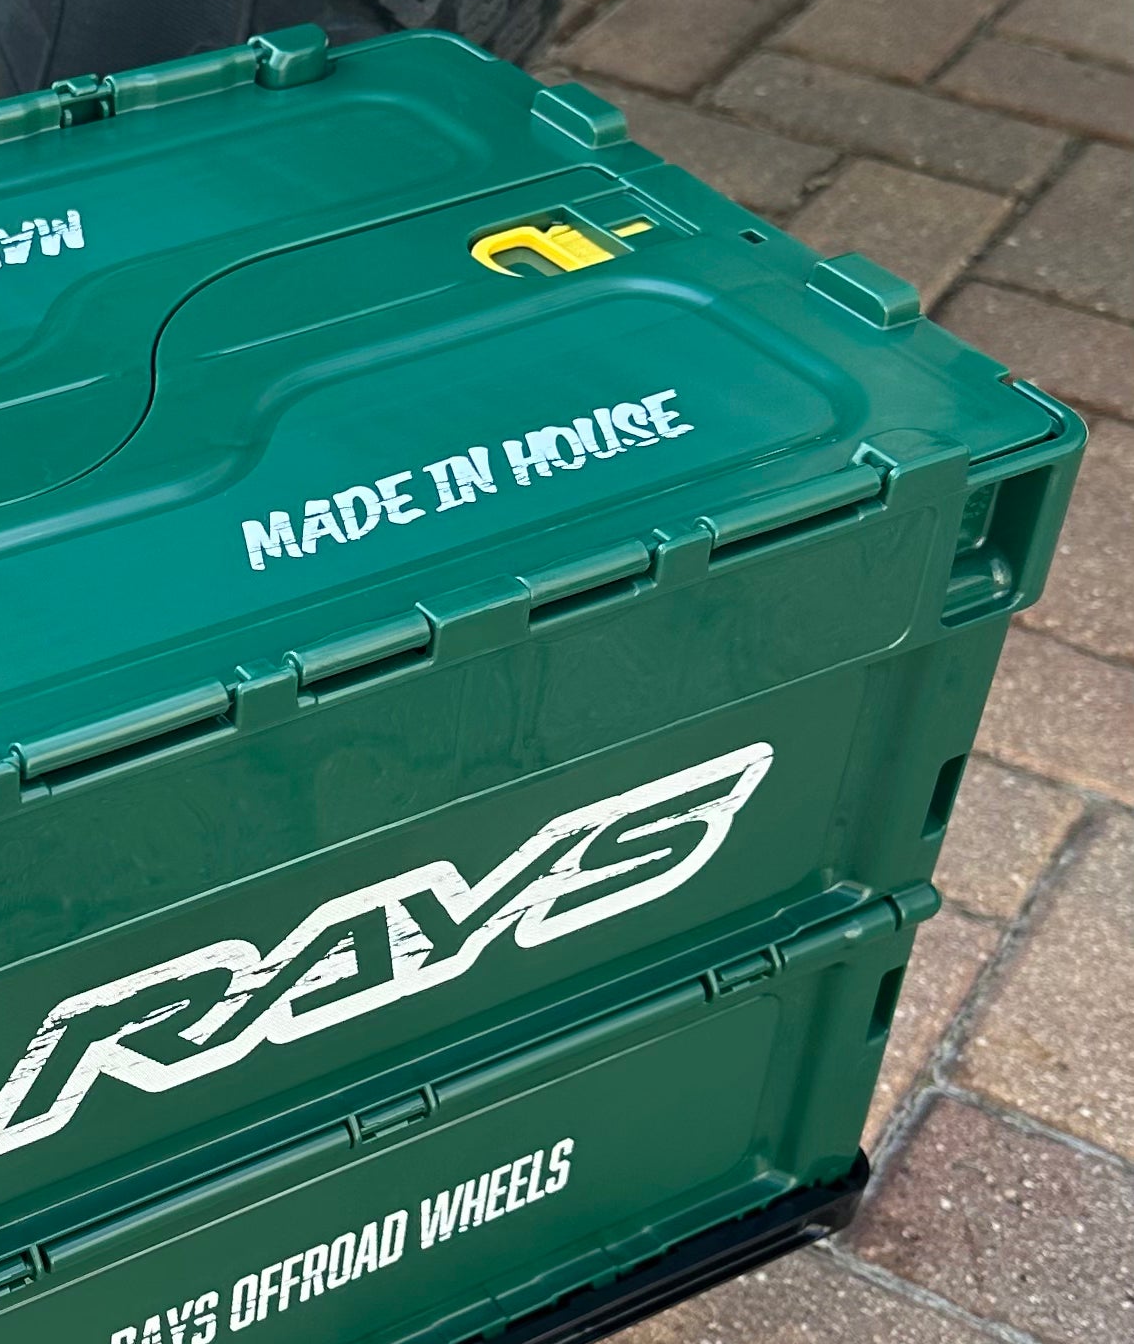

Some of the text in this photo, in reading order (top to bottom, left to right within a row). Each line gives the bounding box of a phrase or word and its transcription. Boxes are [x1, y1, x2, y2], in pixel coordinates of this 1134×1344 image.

[241, 388, 695, 571] MADE IN HOUSE
[229, 1209, 408, 1333] OFFROAD
[420, 1137, 575, 1251] WHEELS
